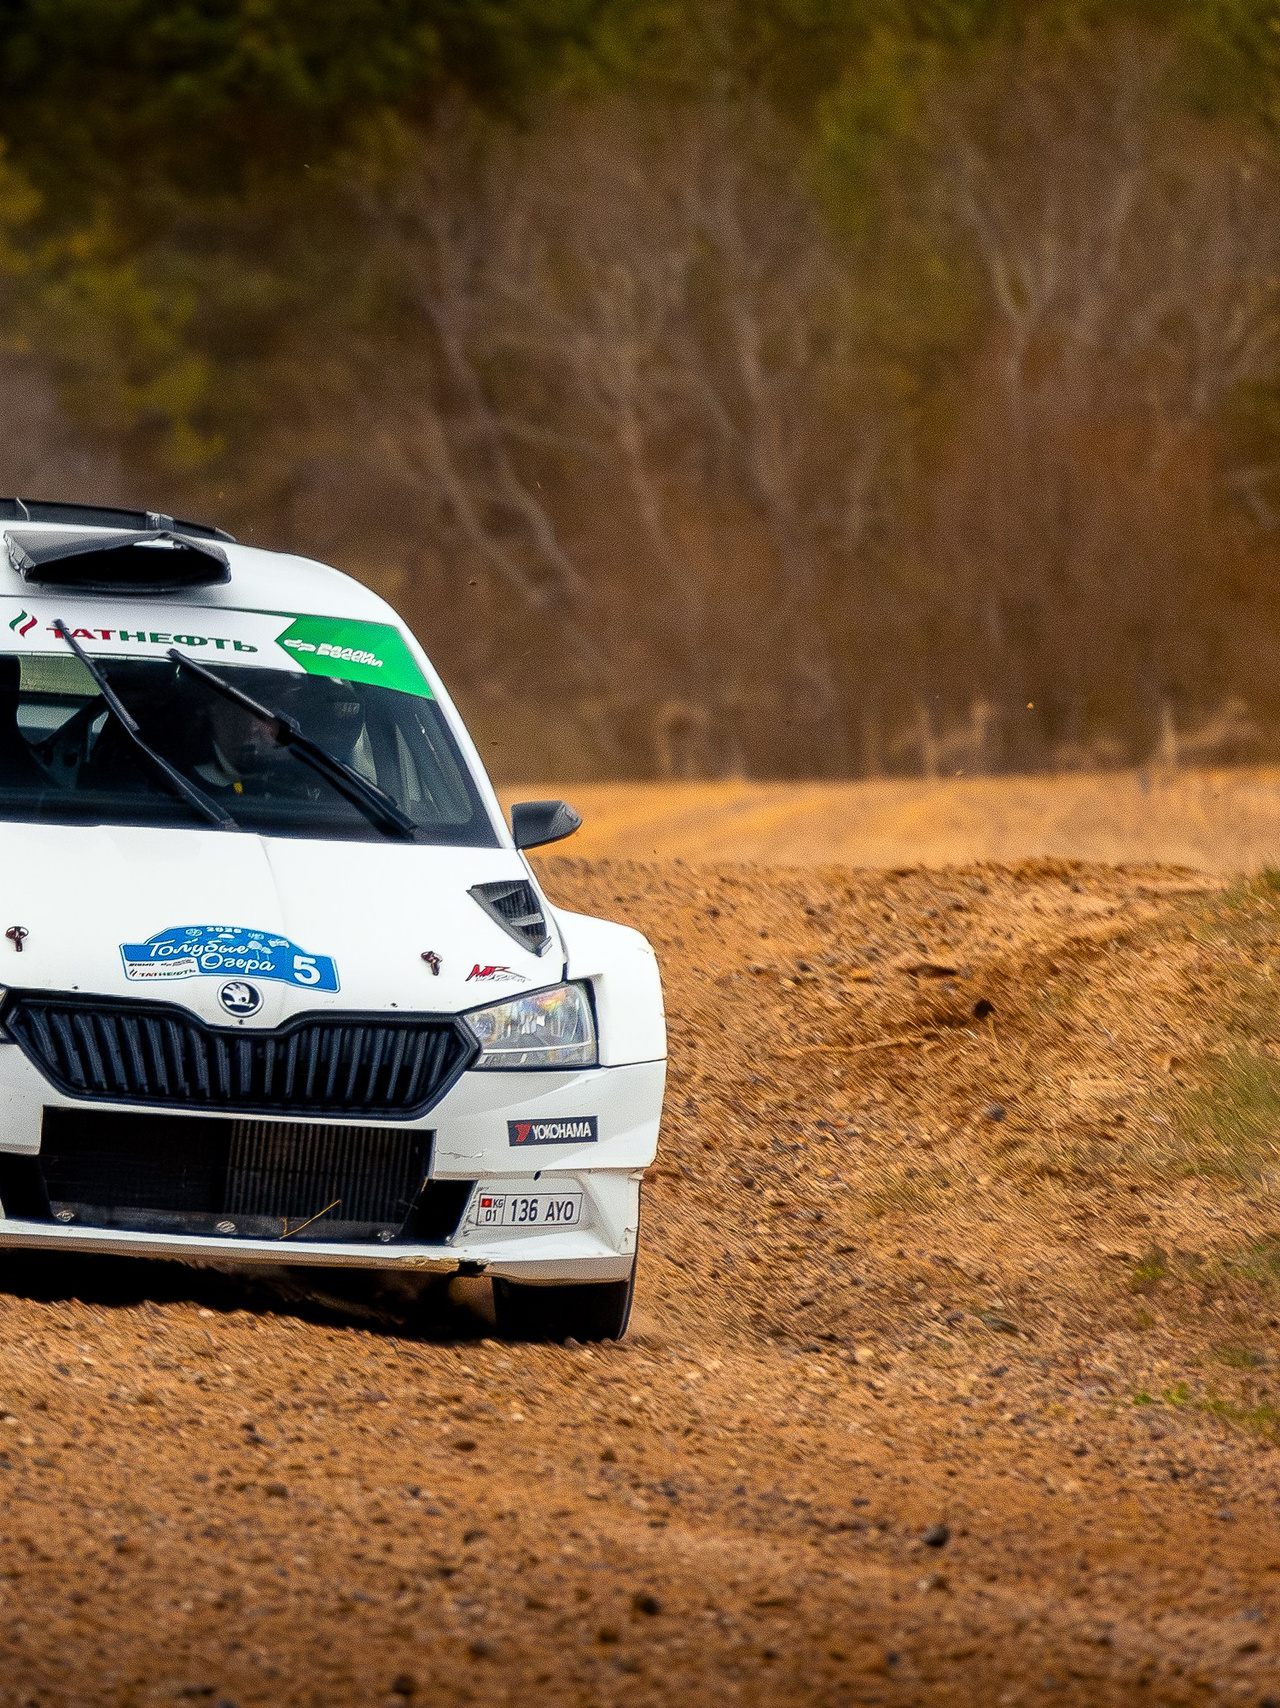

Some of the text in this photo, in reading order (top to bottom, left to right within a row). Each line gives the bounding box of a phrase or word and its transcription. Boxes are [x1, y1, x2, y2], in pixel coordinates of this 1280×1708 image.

[201, 952, 275, 974] Озера
[293, 955, 321, 985] 5
[532, 1121, 592, 1140] YOKOHAMA
[485, 1209, 497, 1222] 01
[511, 1198, 575, 1222] 136 AYO
